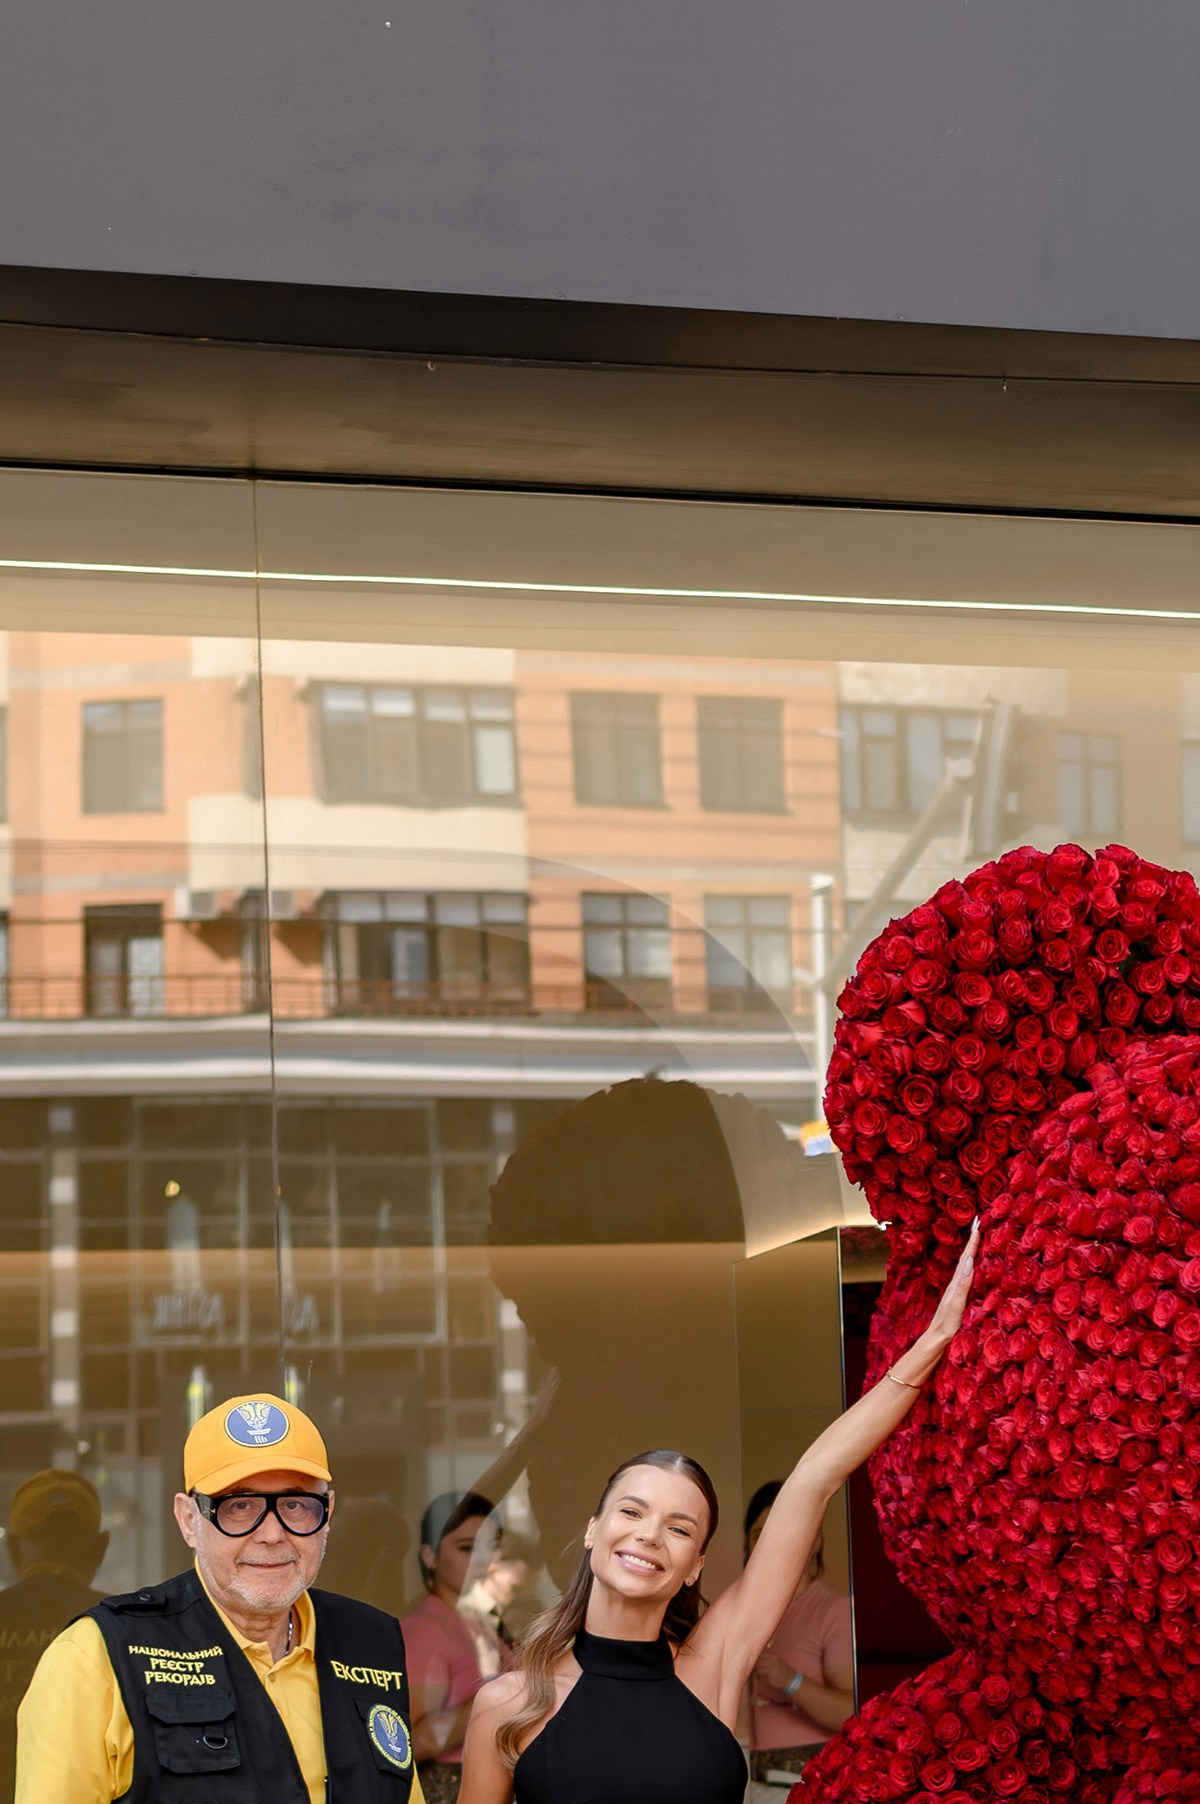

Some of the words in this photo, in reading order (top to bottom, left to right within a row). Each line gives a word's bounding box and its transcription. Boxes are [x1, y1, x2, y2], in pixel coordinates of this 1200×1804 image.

[128, 1645, 224, 1660] НАЦІОНАЛЬНИЙ
[150, 1657, 205, 1674] РЕЄСТР
[144, 1671, 217, 1687] РЕКОРДІВ
[330, 1660, 403, 1692] ЕКСПЕРТ
